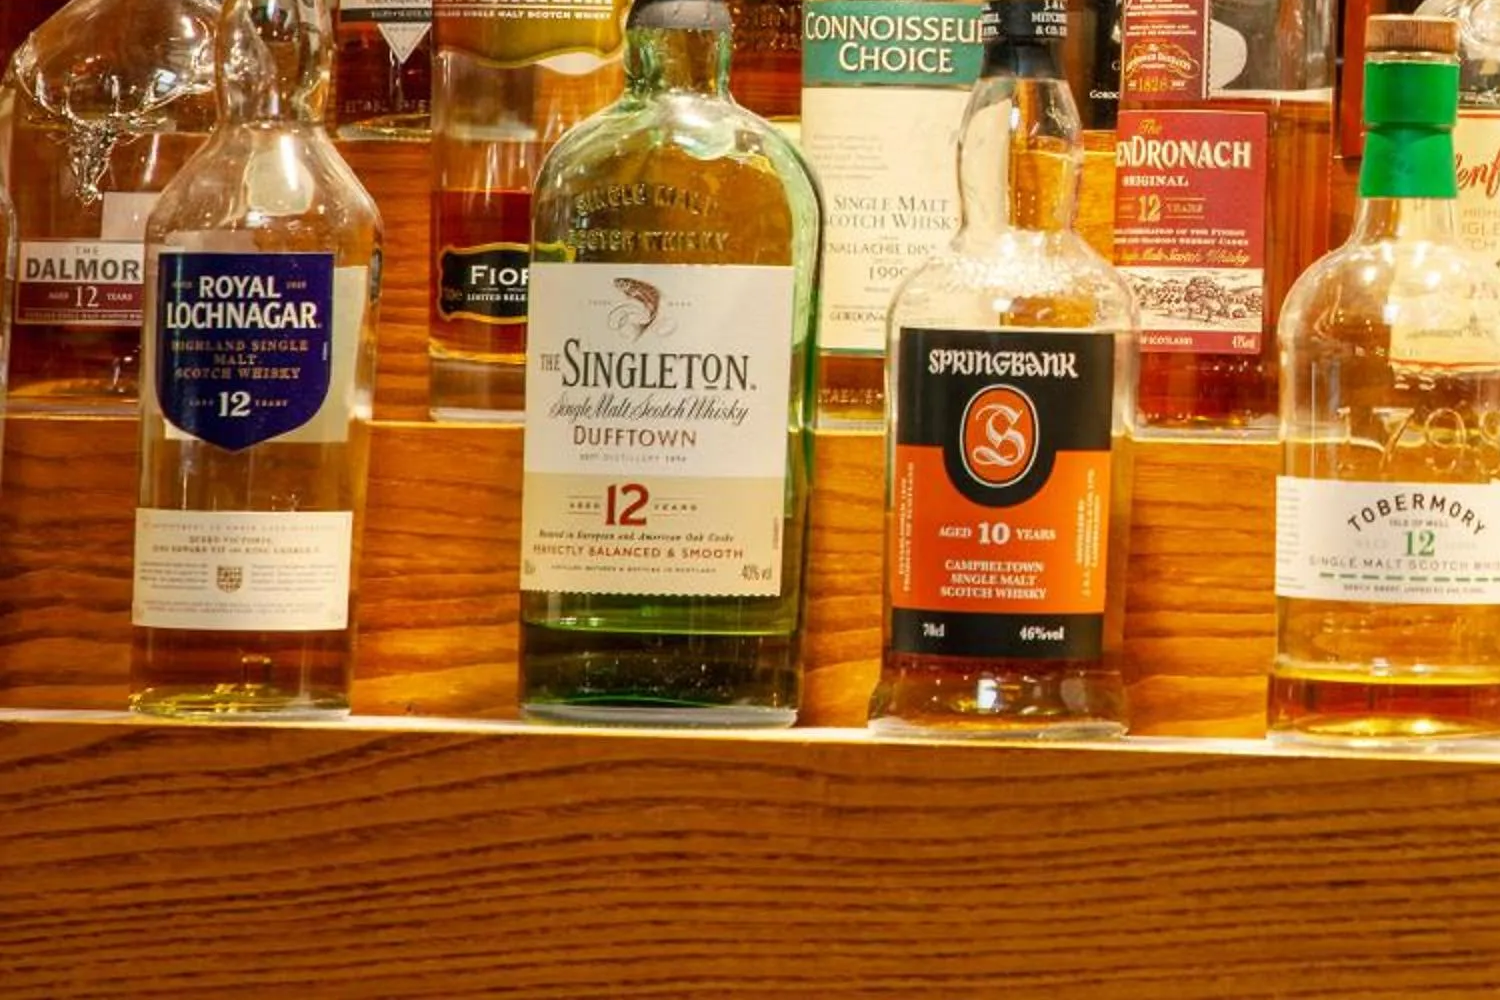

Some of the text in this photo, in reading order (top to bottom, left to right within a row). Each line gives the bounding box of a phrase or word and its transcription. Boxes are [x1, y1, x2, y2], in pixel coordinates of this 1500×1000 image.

[528, 11, 570, 19] SCOTCH
[839, 42, 954, 73] CHOICE
[1139, 119, 1162, 134] The
[833, 194, 951, 212] SINGLE MALT
[1139, 195, 1160, 221] 12
[26, 258, 139, 280] DALMOR
[75, 286, 99, 307] 12
[199, 276, 281, 298] ROYAL
[167, 302, 317, 329] LOCHNAGAR
[171, 339, 308, 352] HIGHLAND SINGLE
[213, 353, 254, 365] MALT
[540, 339, 751, 390] THE SINGLETON
[928, 349, 1079, 379] SPRINGBANK
[175, 367, 301, 380] SCOTCH WHISKY
[217, 391, 251, 417] 12
[549, 392, 750, 428] Single Malt Scotch Whisky
[573, 425, 697, 447] DUFFTOWN
[604, 483, 649, 527] 12
[1348, 493, 1485, 536] TOBERMORY
[577, 530, 614, 543] European
[618, 532, 636, 541] and
[638, 532, 682, 542] American
[939, 521, 1056, 544] AGED 10 YEARS
[589, 545, 743, 560] BALANCED & SMOOTH
[1403, 530, 1435, 557] 12
[945, 560, 1044, 572] CAMPBELTOWN
[1310, 557, 1471, 571] SINGLE MALT SCOTCH
[951, 573, 1036, 586] SINGLE MALT
[940, 587, 1046, 600] SCOTCH WHISKY
[923, 624, 945, 638] 70cl
